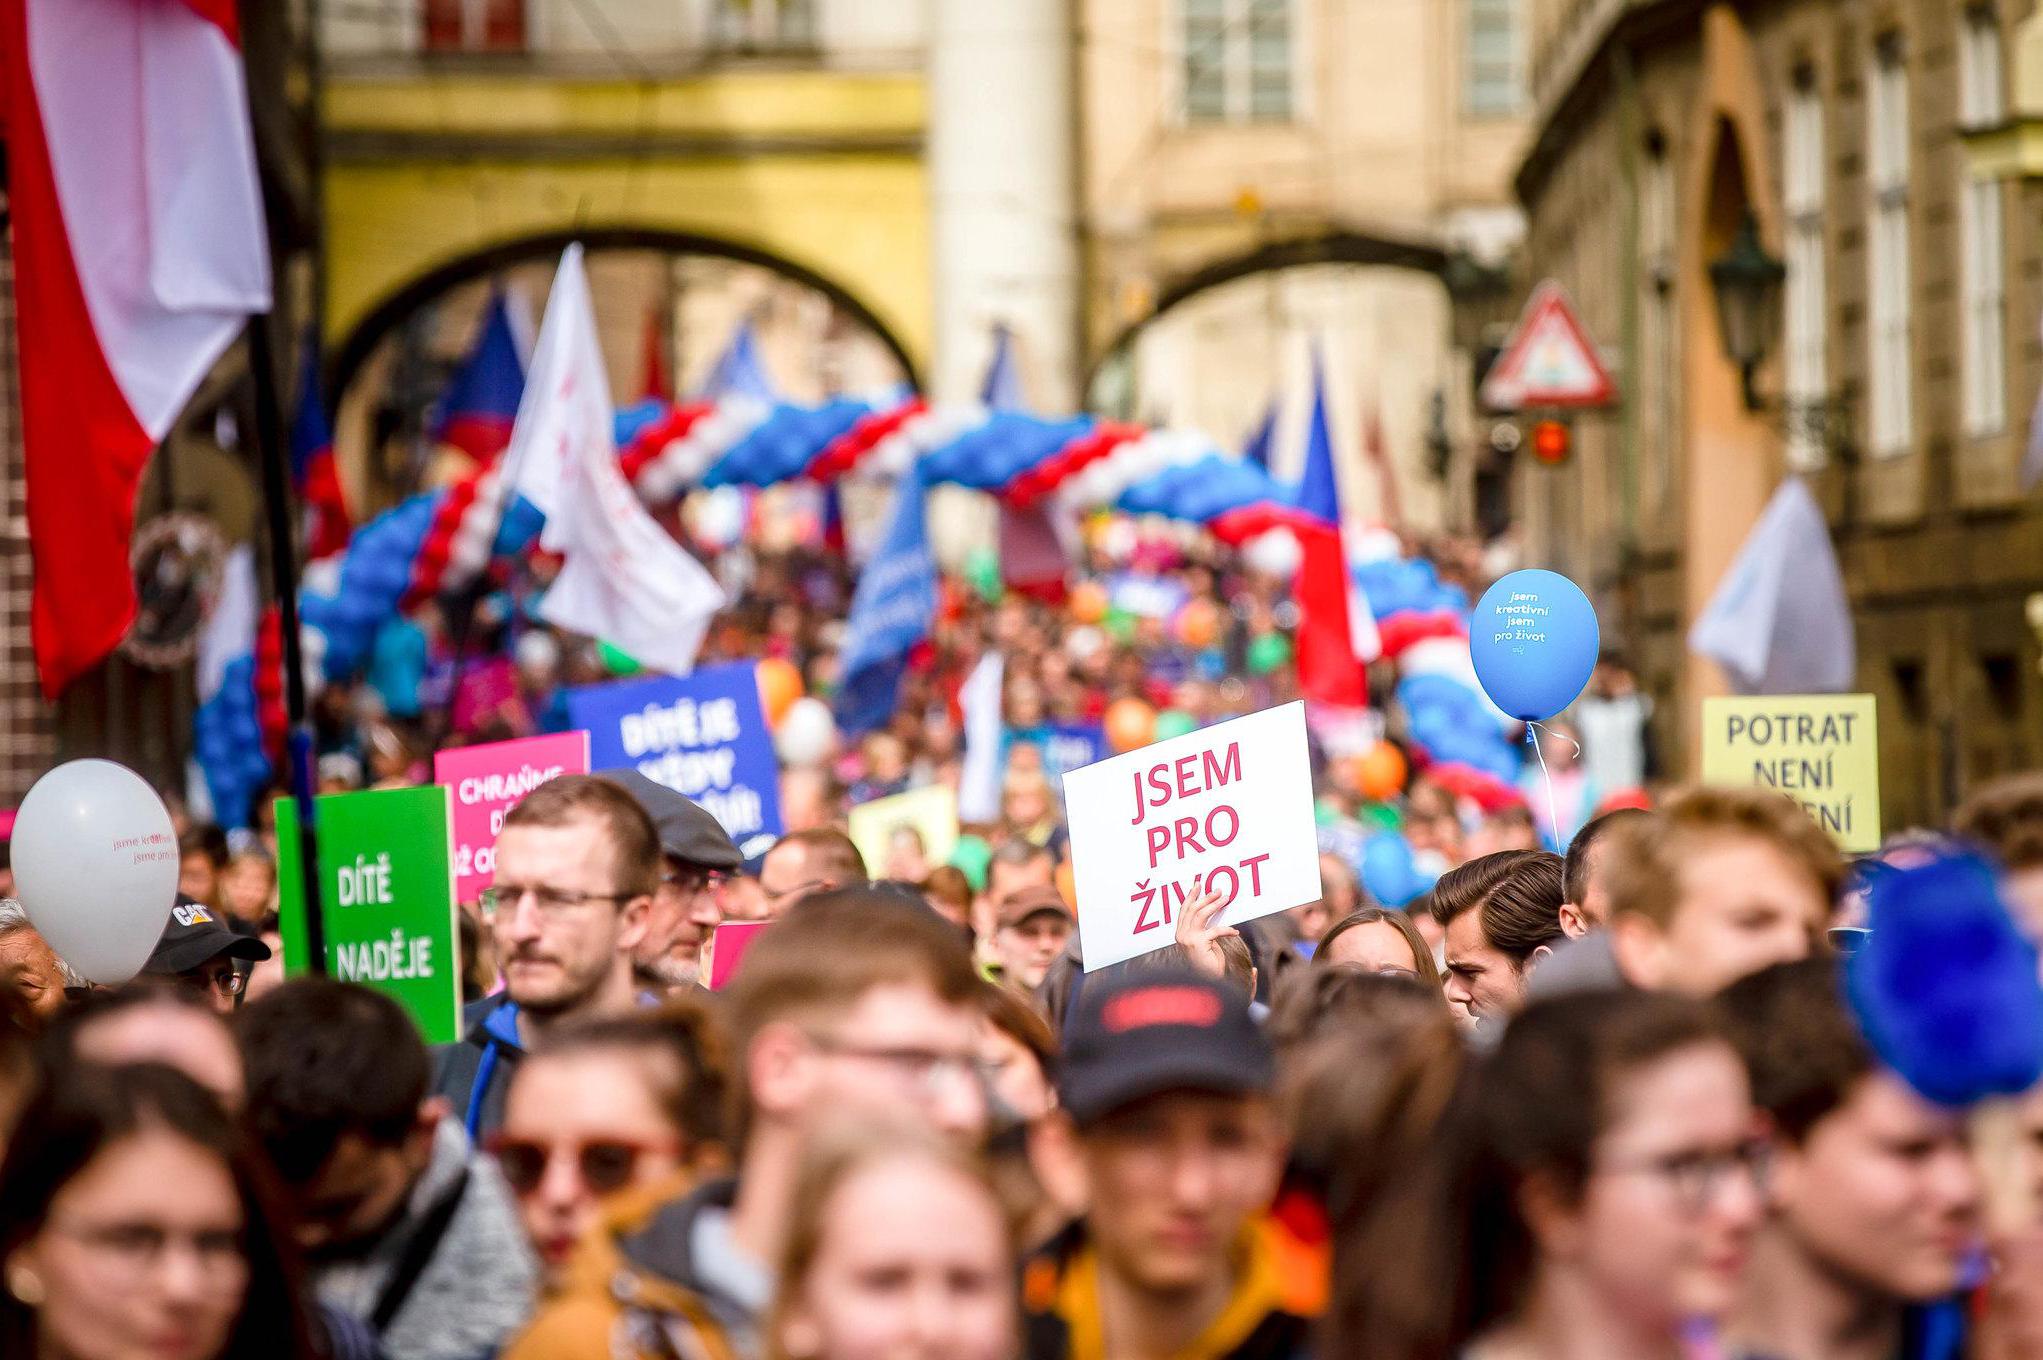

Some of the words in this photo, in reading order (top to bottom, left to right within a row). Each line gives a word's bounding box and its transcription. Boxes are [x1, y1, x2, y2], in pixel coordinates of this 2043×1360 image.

[1495, 604, 1550, 616] kreativní
[1509, 591, 1538, 604] jsem
[1494, 632, 1513, 644] pro
[1515, 629, 1546, 643] život
[1505, 615, 1535, 629] jsem
[1727, 712, 1858, 746] POTRAT
[1131, 742, 1242, 825] JSEM
[1754, 751, 1835, 790] NENÍ
[1147, 804, 1240, 868] PRO
[337, 851, 394, 907] DÍTĚ
[172, 904, 213, 927] CAT
[336, 926, 434, 982] NADĚJE
